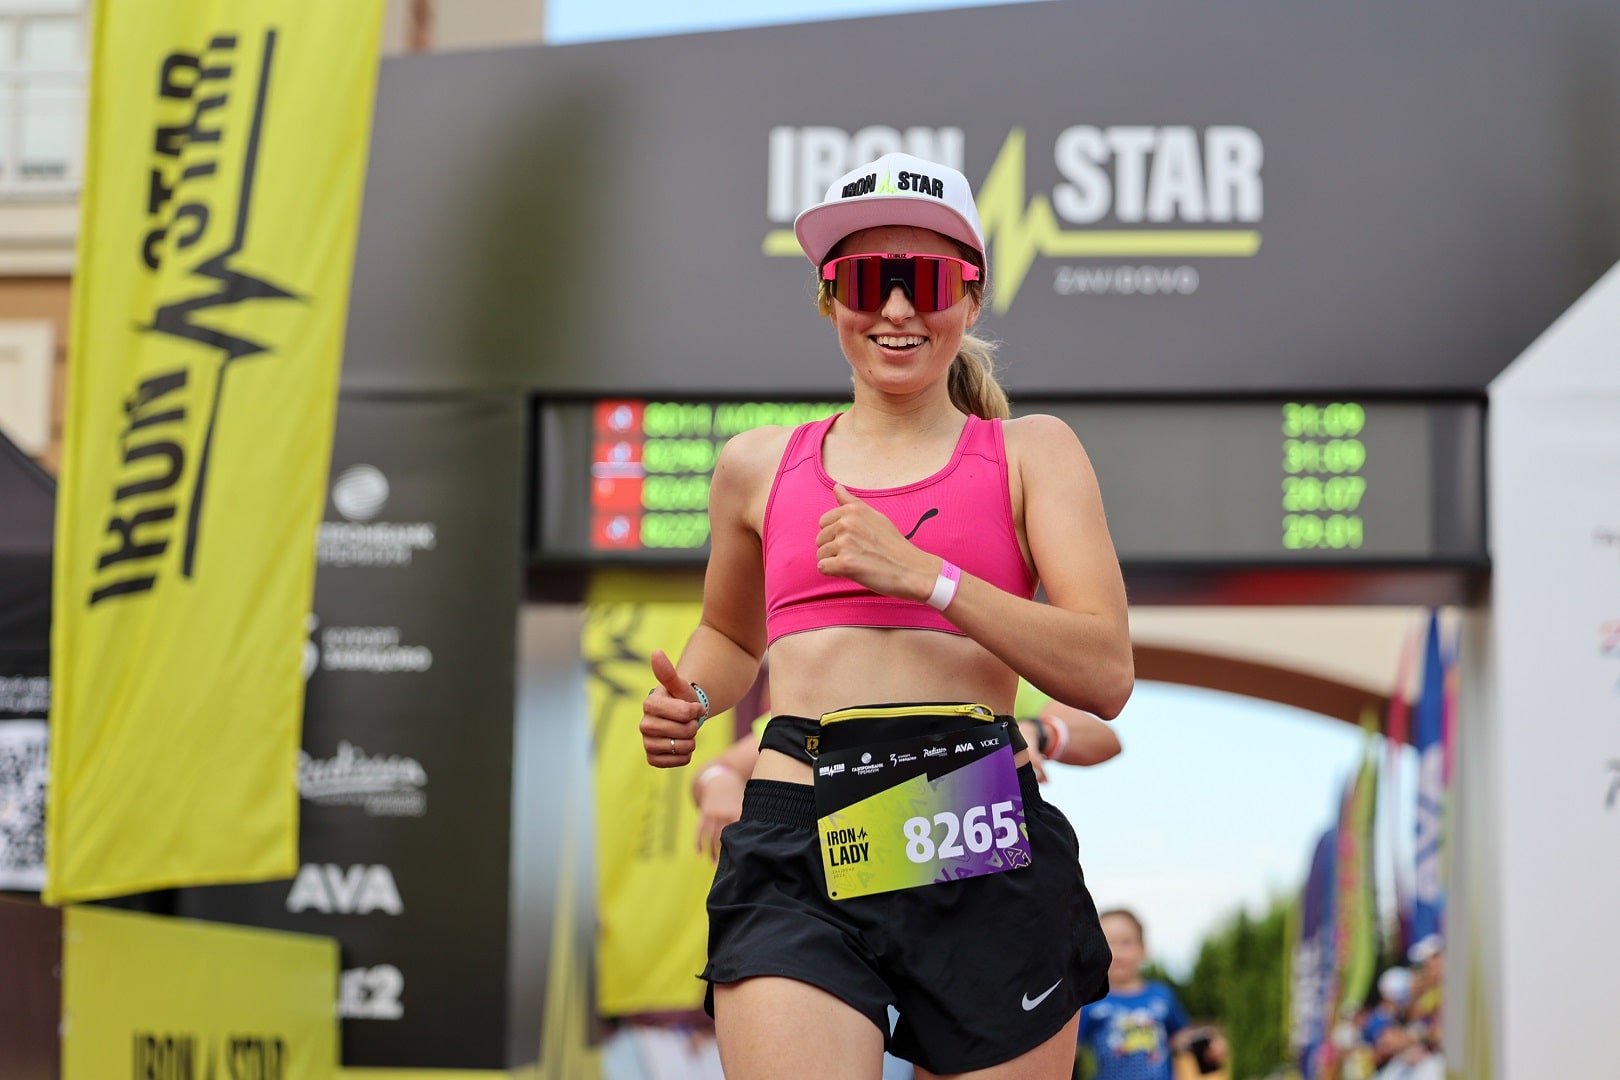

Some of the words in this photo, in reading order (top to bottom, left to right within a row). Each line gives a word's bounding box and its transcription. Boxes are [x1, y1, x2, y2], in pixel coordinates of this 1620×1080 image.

[841, 172, 877, 199] IRON
[897, 170, 944, 199] STAR
[1053, 124, 1265, 224] STAR
[1053, 265, 1200, 296] ZAVIDOVO
[954, 742, 975, 754] AVA
[980, 738, 1000, 748] VOICE
[826, 827, 857, 846] IRON
[903, 800, 1018, 864] 8265
[829, 842, 869, 867] LADY
[286, 862, 404, 915] AVA
